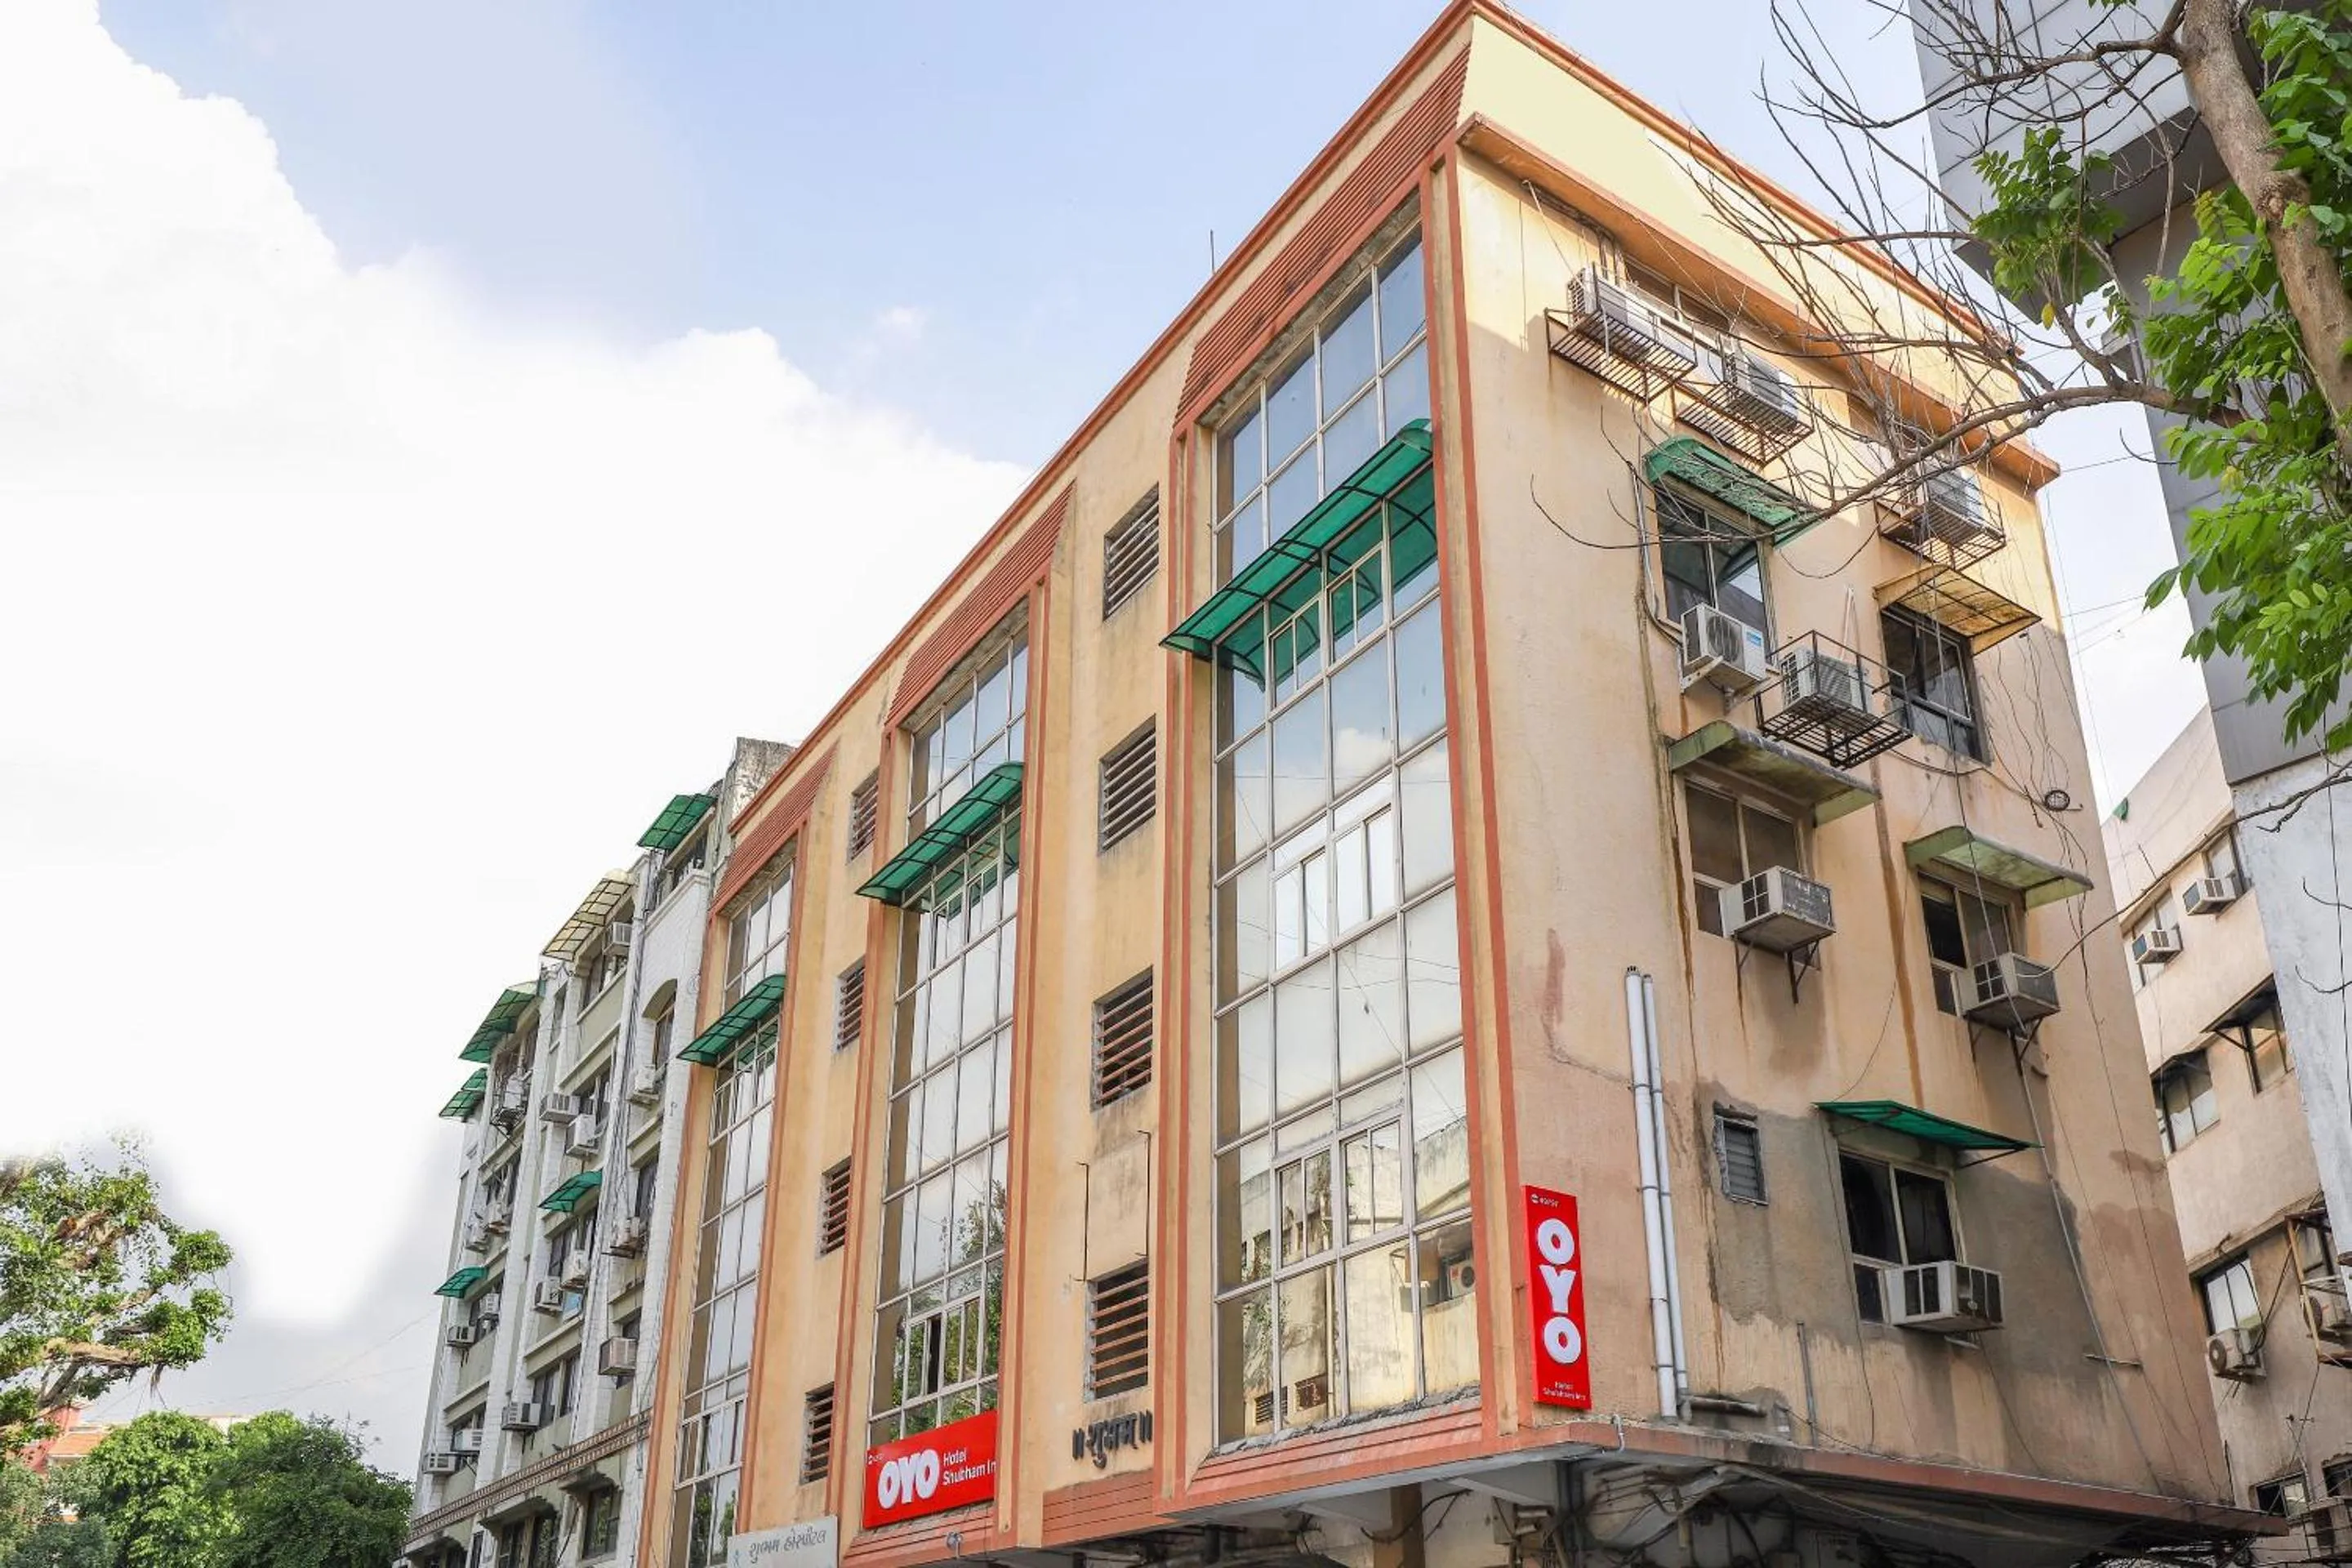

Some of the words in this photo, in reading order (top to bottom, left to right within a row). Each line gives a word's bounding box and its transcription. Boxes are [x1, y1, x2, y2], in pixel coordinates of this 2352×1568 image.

[1537, 1218, 1582, 1365] OYO
[878, 1449, 939, 1509] OYO
[943, 1448, 967, 1467] Hotel
